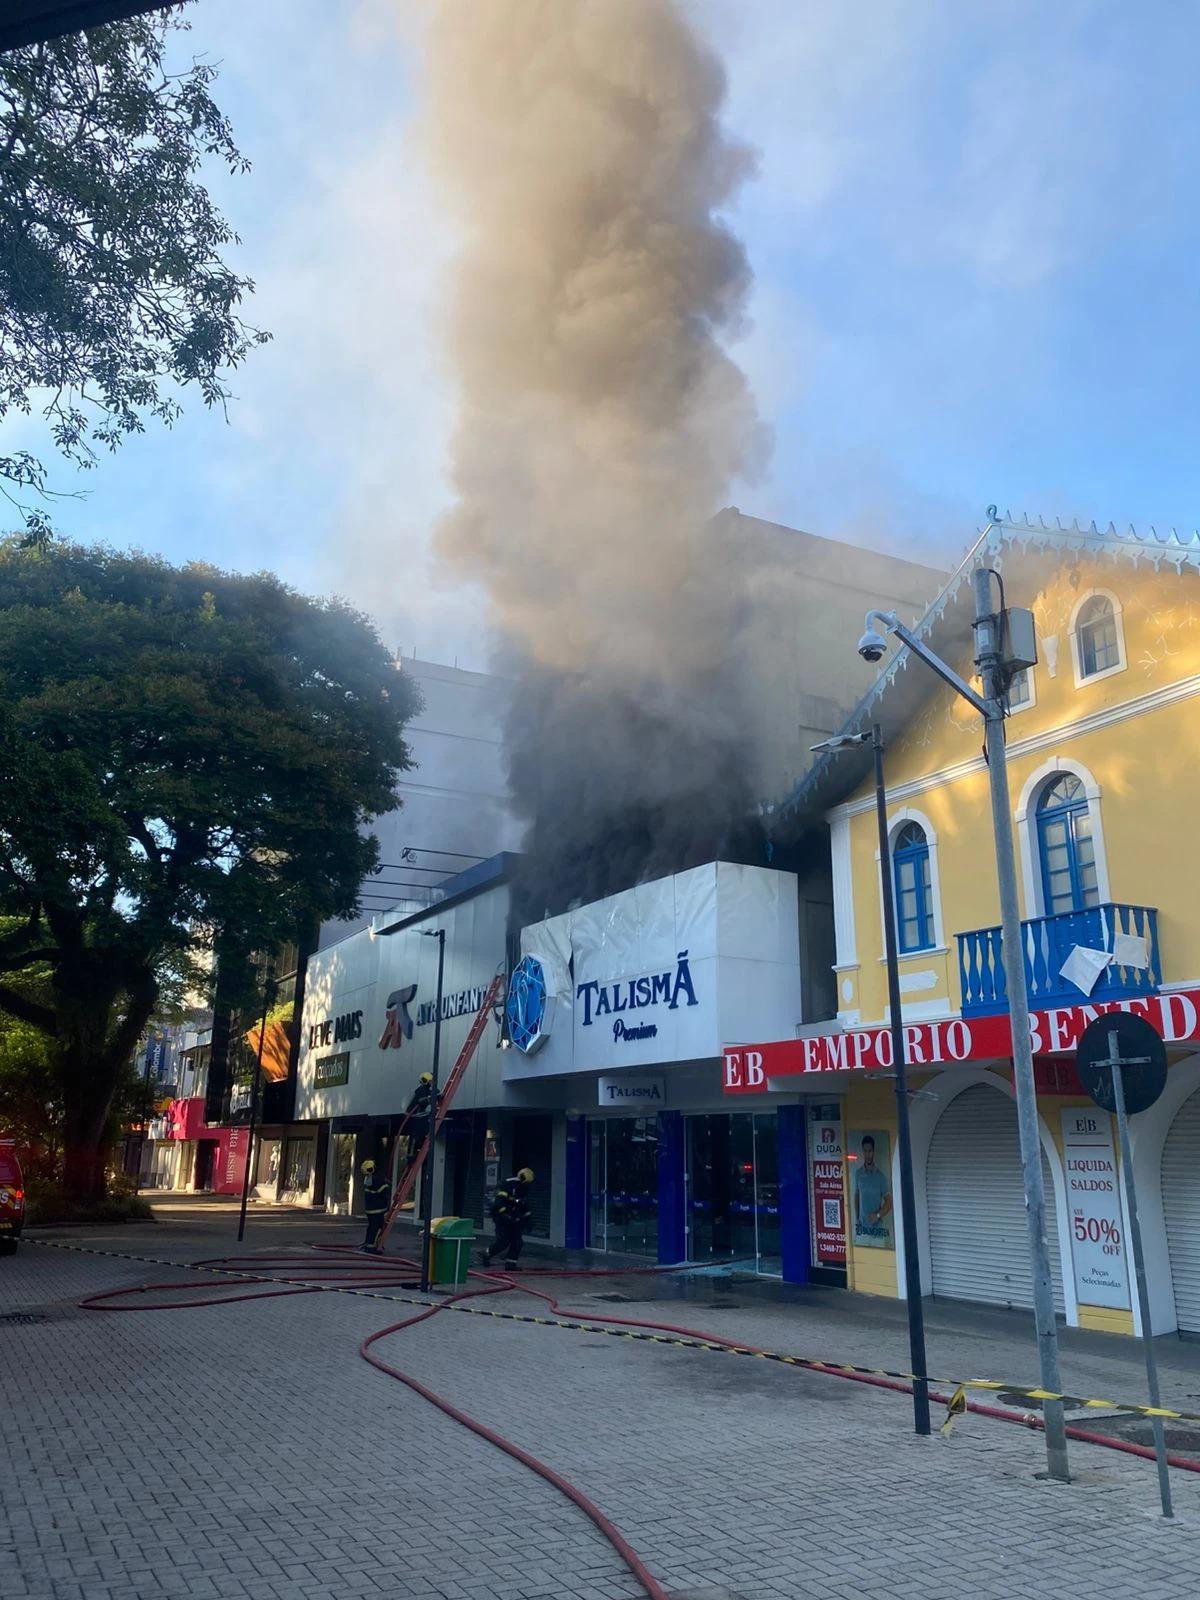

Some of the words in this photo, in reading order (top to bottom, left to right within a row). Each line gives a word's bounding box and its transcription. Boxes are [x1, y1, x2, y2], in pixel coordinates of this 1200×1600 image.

[577, 949, 699, 1026] TALISMÃ
[309, 1020, 333, 1050] LEVE
[335, 1010, 363, 1043] MAIS
[613, 1018, 658, 1042] Premium
[802, 1020, 972, 1073] EMPORIO
[1027, 993, 1198, 1054] BED
[816, 1144, 842, 1153] DUDA
[1067, 1160, 1113, 1173] LIQUIDA
[1070, 1179, 1113, 1192] SALDOS
[1074, 1216, 1120, 1244] 50%
[1102, 1244, 1121, 1256] OFF
[1091, 1268, 1109, 1277] Peças
